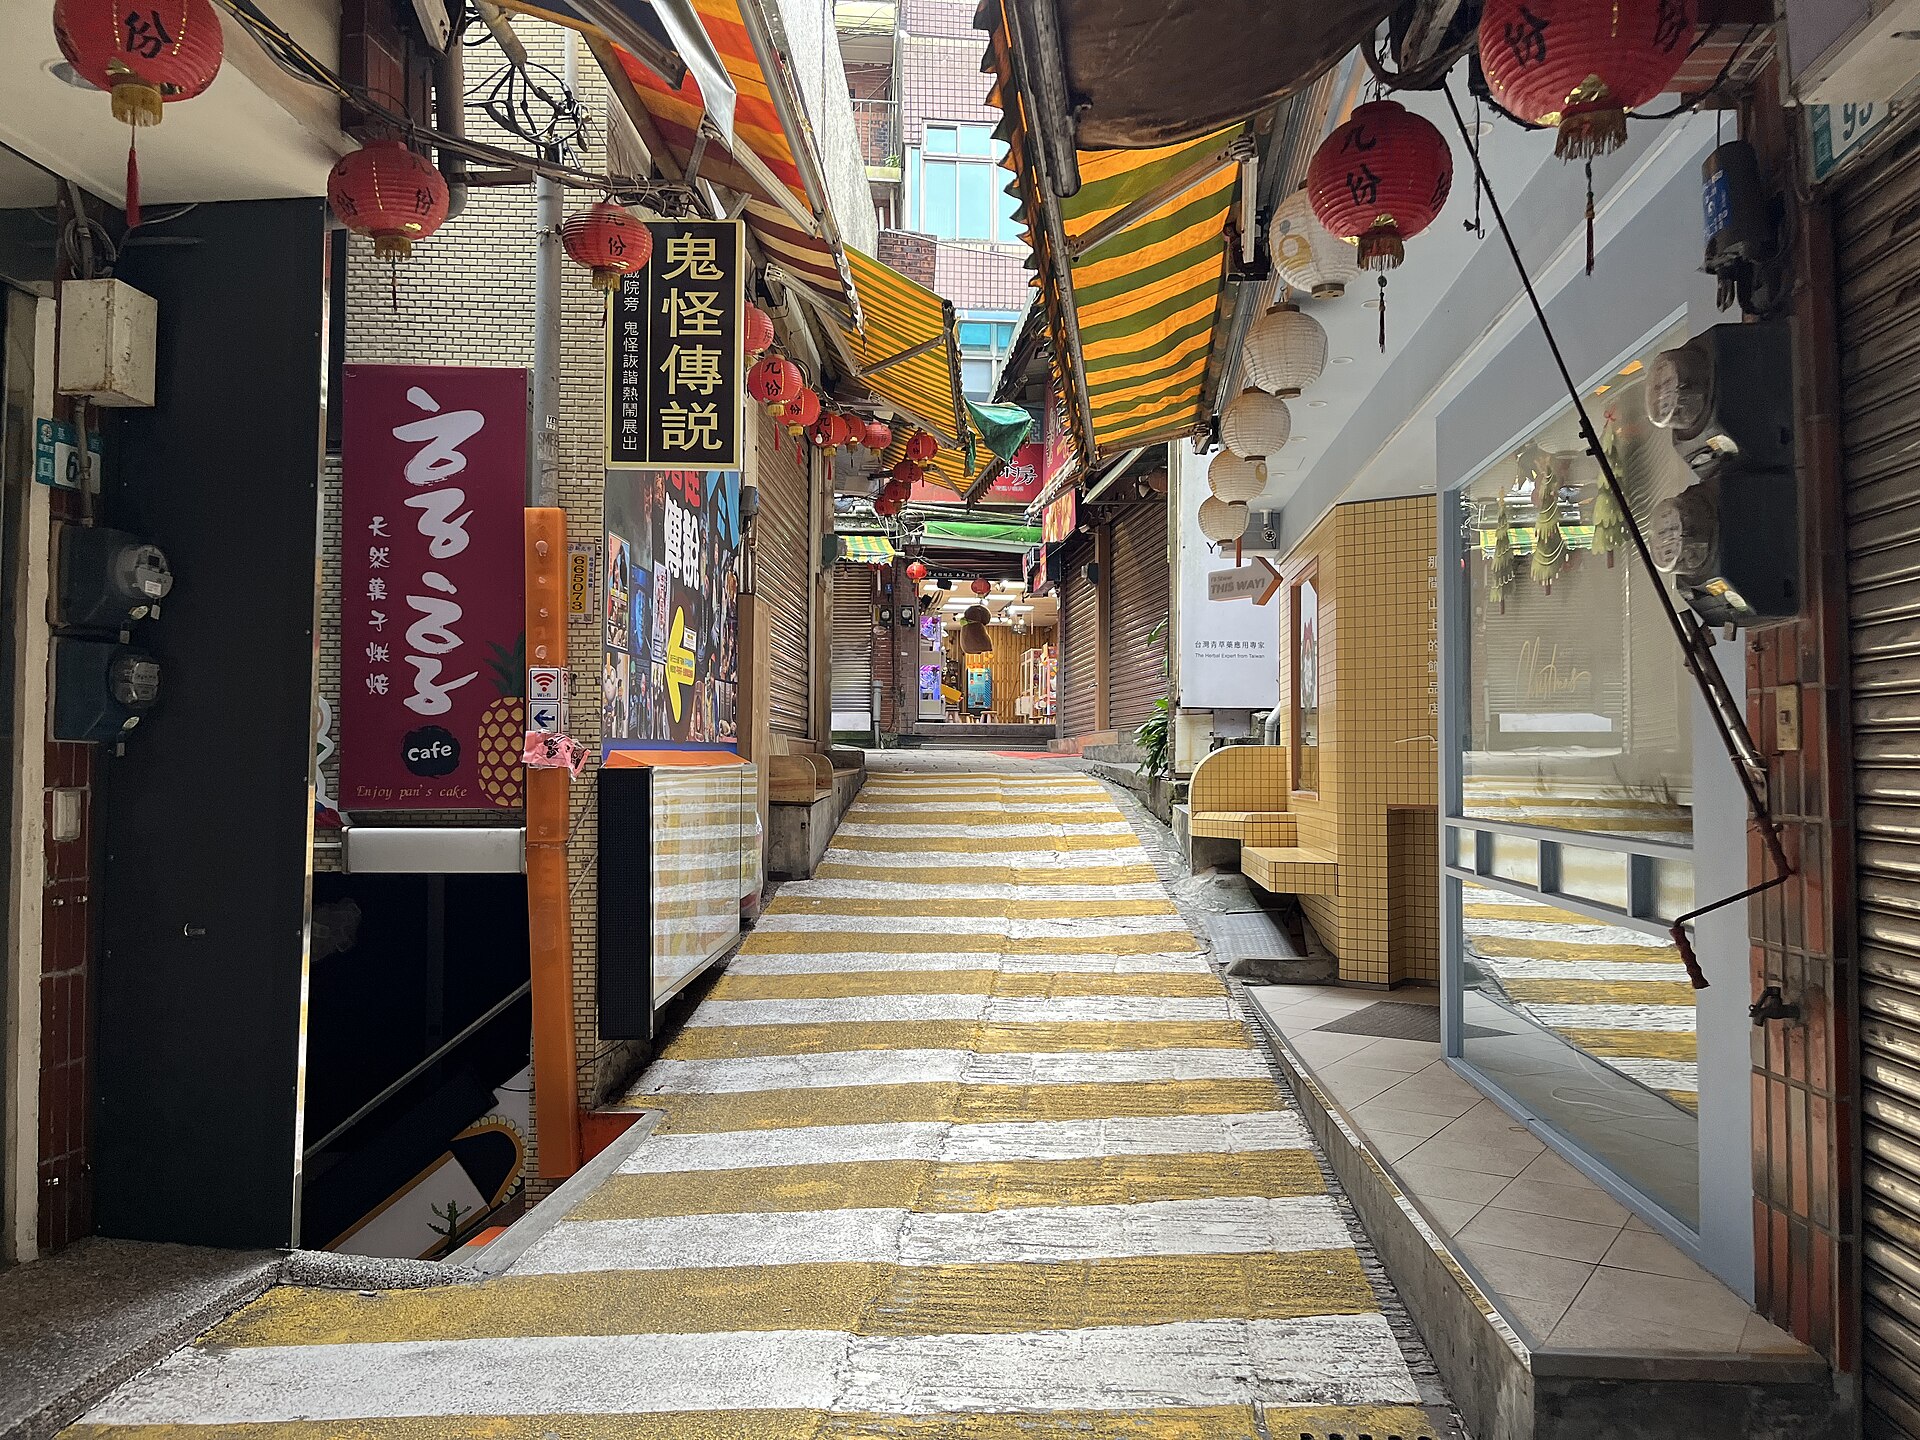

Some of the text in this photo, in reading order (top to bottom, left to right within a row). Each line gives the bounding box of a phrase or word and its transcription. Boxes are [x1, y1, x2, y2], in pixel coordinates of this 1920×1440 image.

[124, 10, 174, 59] 份
[1340, 123, 1382, 206] 九份
[606, 214, 627, 257] 九份
[765, 361, 782, 397] 九份
[571, 555, 585, 611] 665073
[1210, 577, 1265, 594] THIS WAY!
[366, 515, 392, 696] 天然菓子烘焙
[1194, 640, 1265, 649] 台灣青草藥應用專家
[407, 741, 452, 762] cafe
[356, 785, 392, 801] Enjoy
[439, 785, 468, 798] cake
